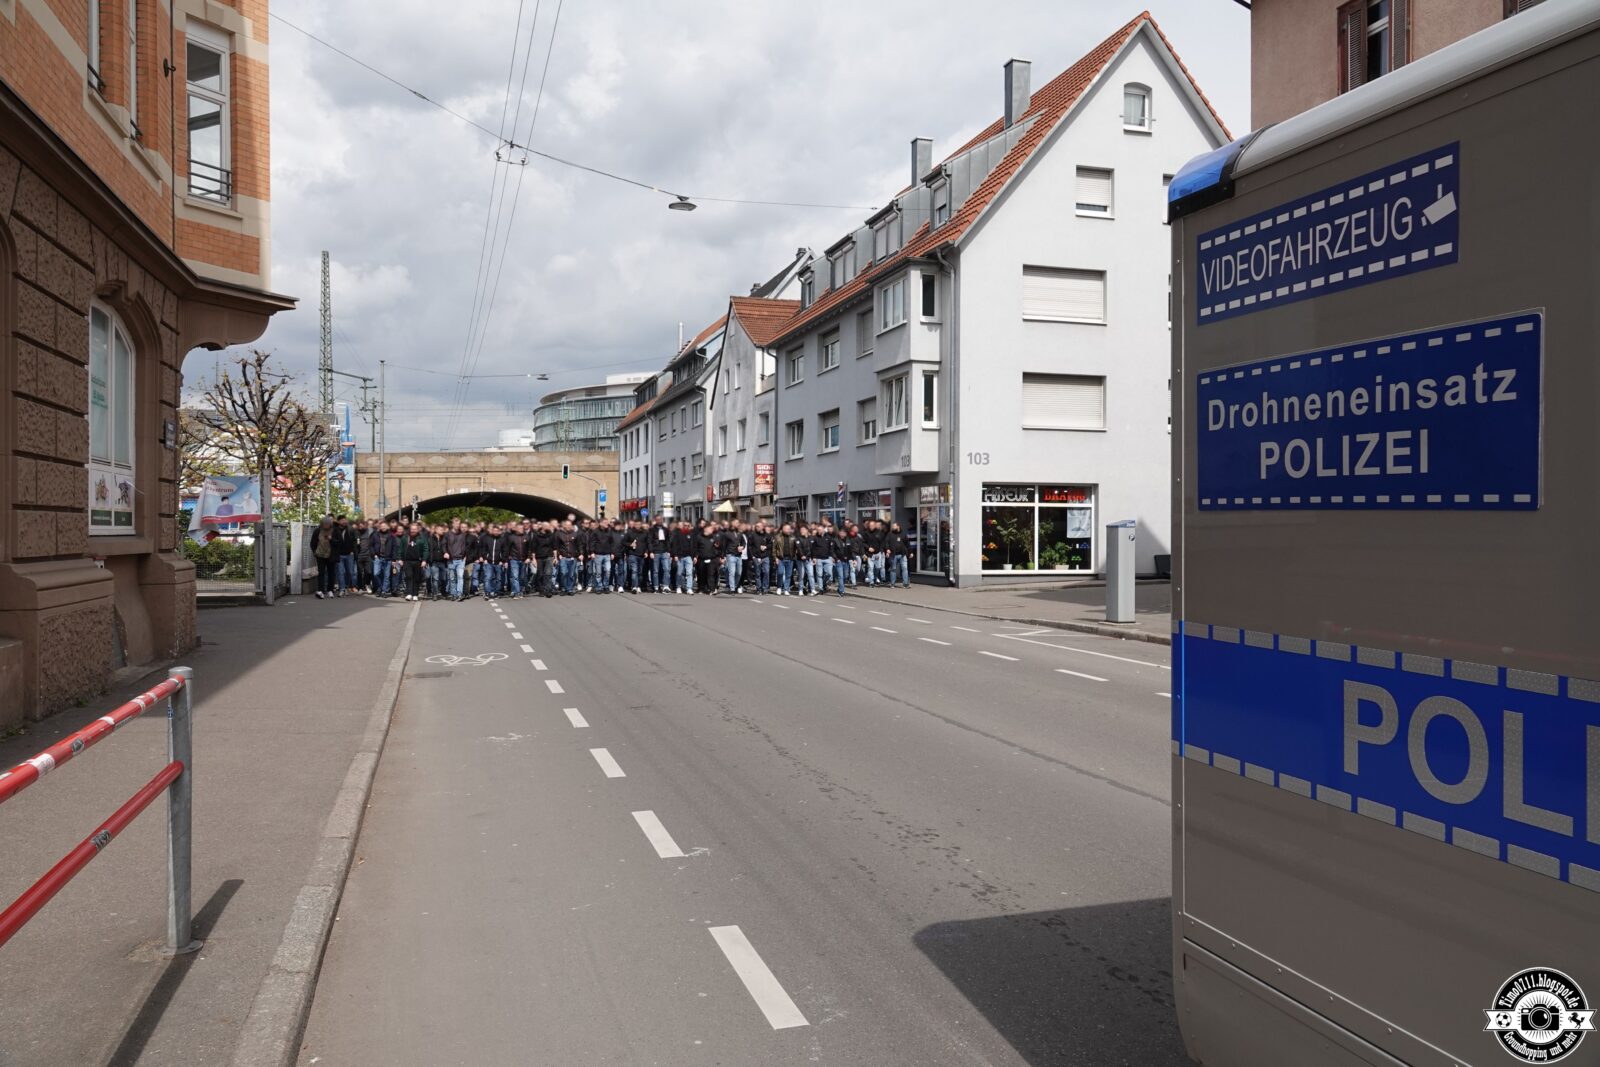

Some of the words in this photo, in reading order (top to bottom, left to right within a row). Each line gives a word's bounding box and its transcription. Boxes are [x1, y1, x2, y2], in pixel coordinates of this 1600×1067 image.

[1202, 197, 1413, 295] VIDEOFAHRZEUG
[1208, 362, 1518, 431] Drohneneinsatz
[901, 455, 911, 468] 103
[967, 452, 990, 465] 103
[1260, 428, 1429, 480] POLIZEI
